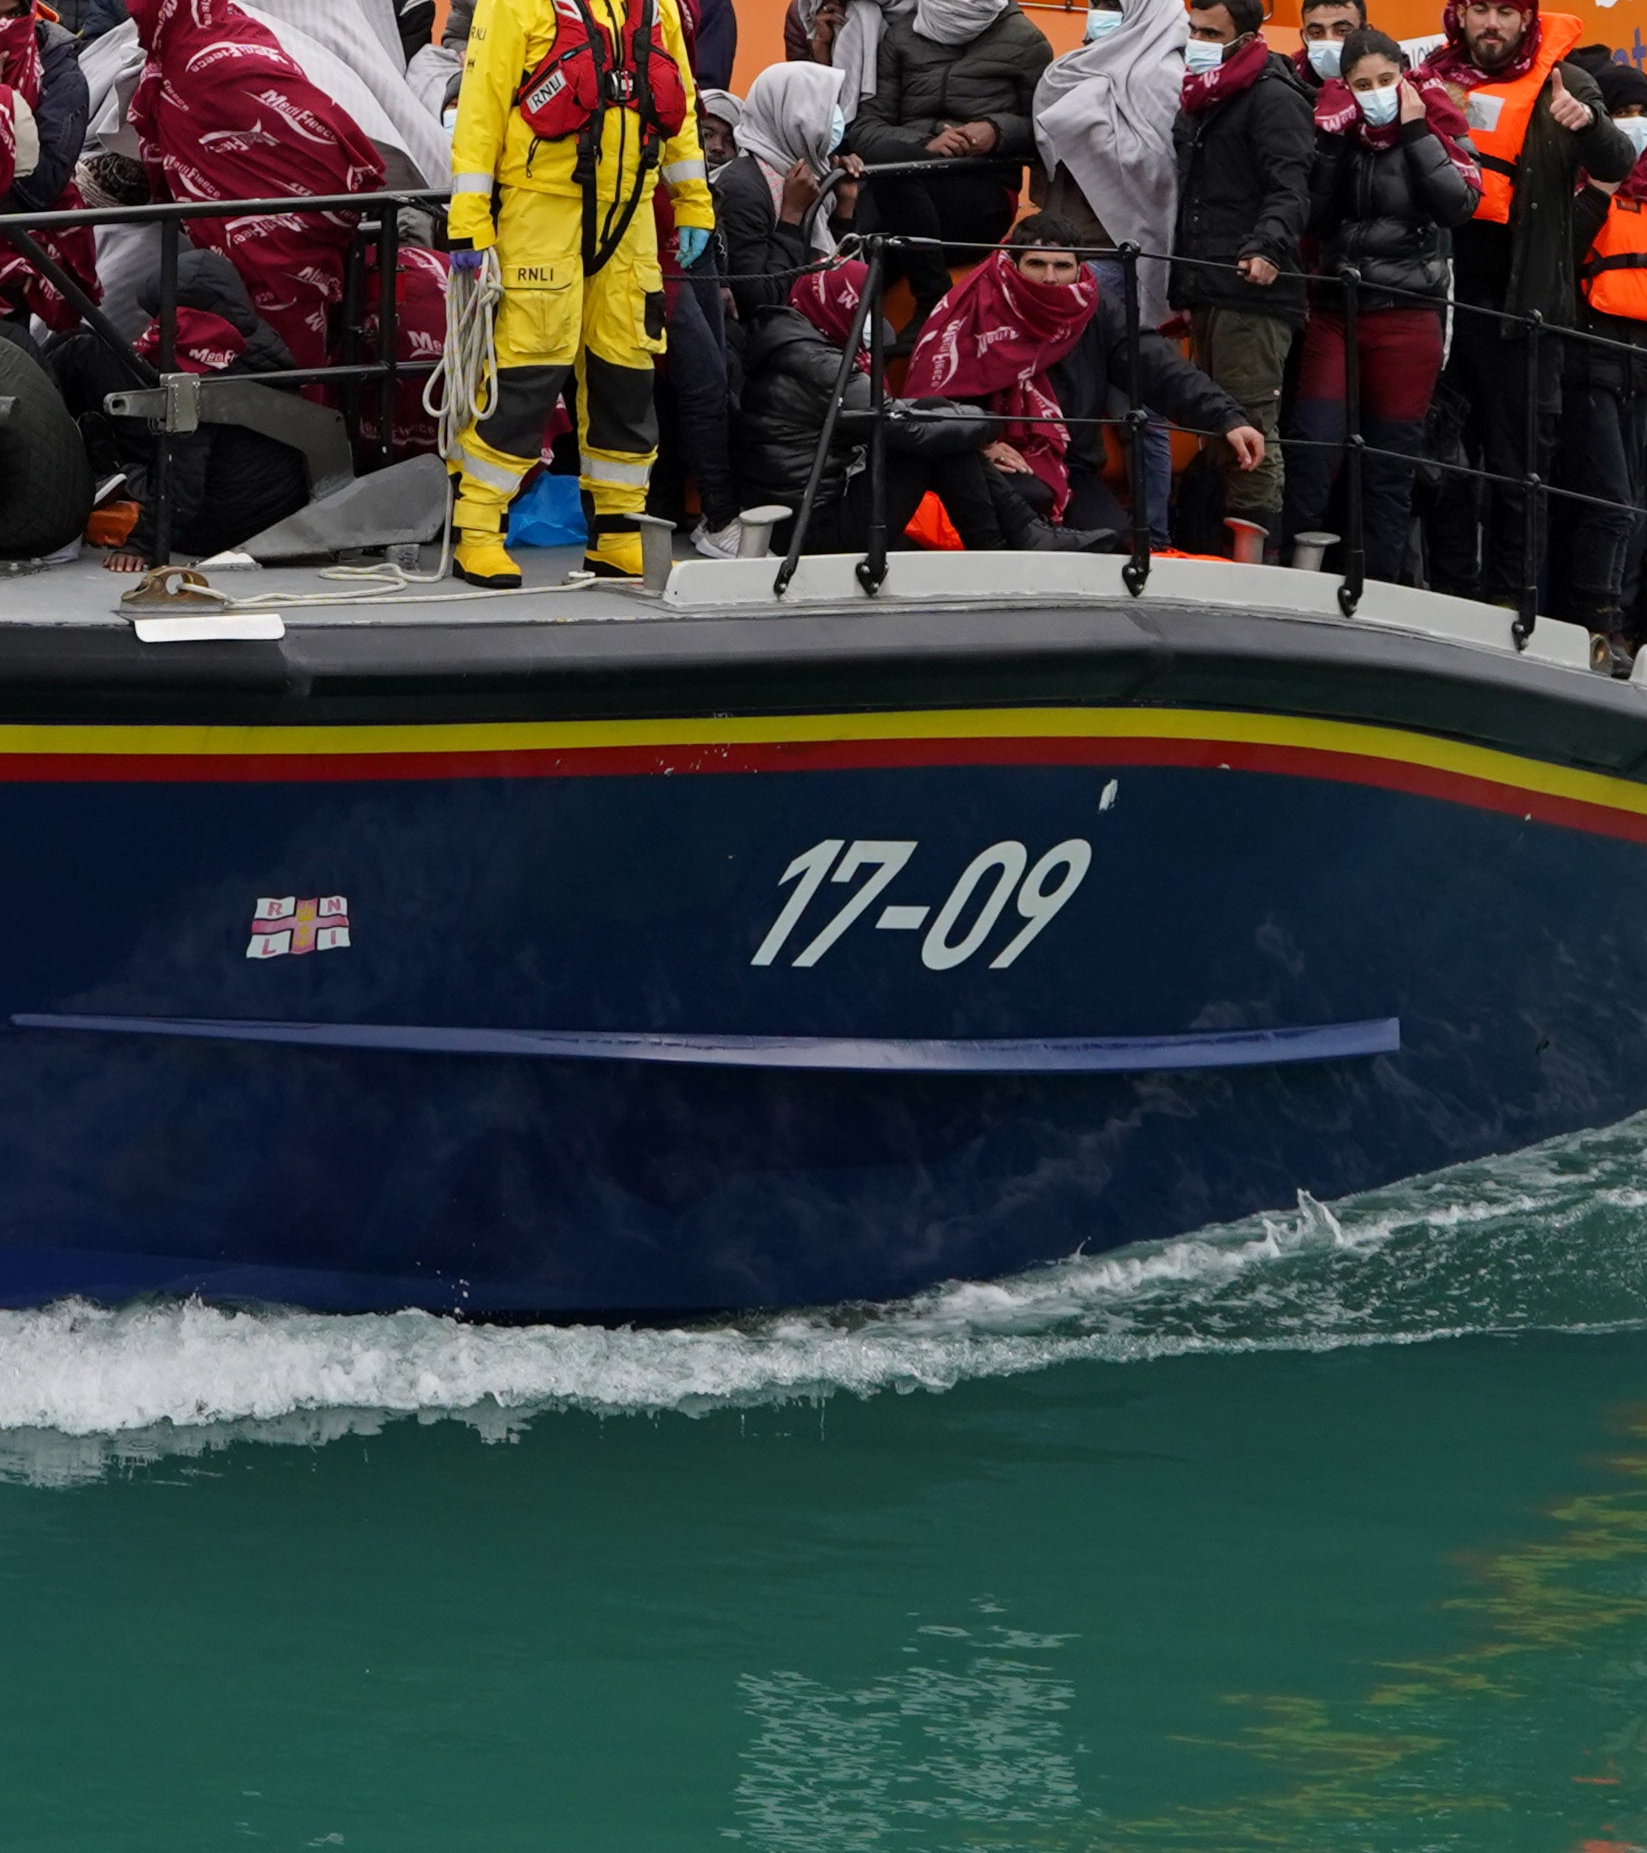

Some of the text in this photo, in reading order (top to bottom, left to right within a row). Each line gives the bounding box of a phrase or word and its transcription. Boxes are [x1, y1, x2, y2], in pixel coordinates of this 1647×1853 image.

[531, 75, 562, 108] RNLI
[517, 267, 554, 282] RNLI
[266, 897, 342, 917] R N
[750, 838, 1093, 971] 17-09
[260, 929, 337, 956] L I
